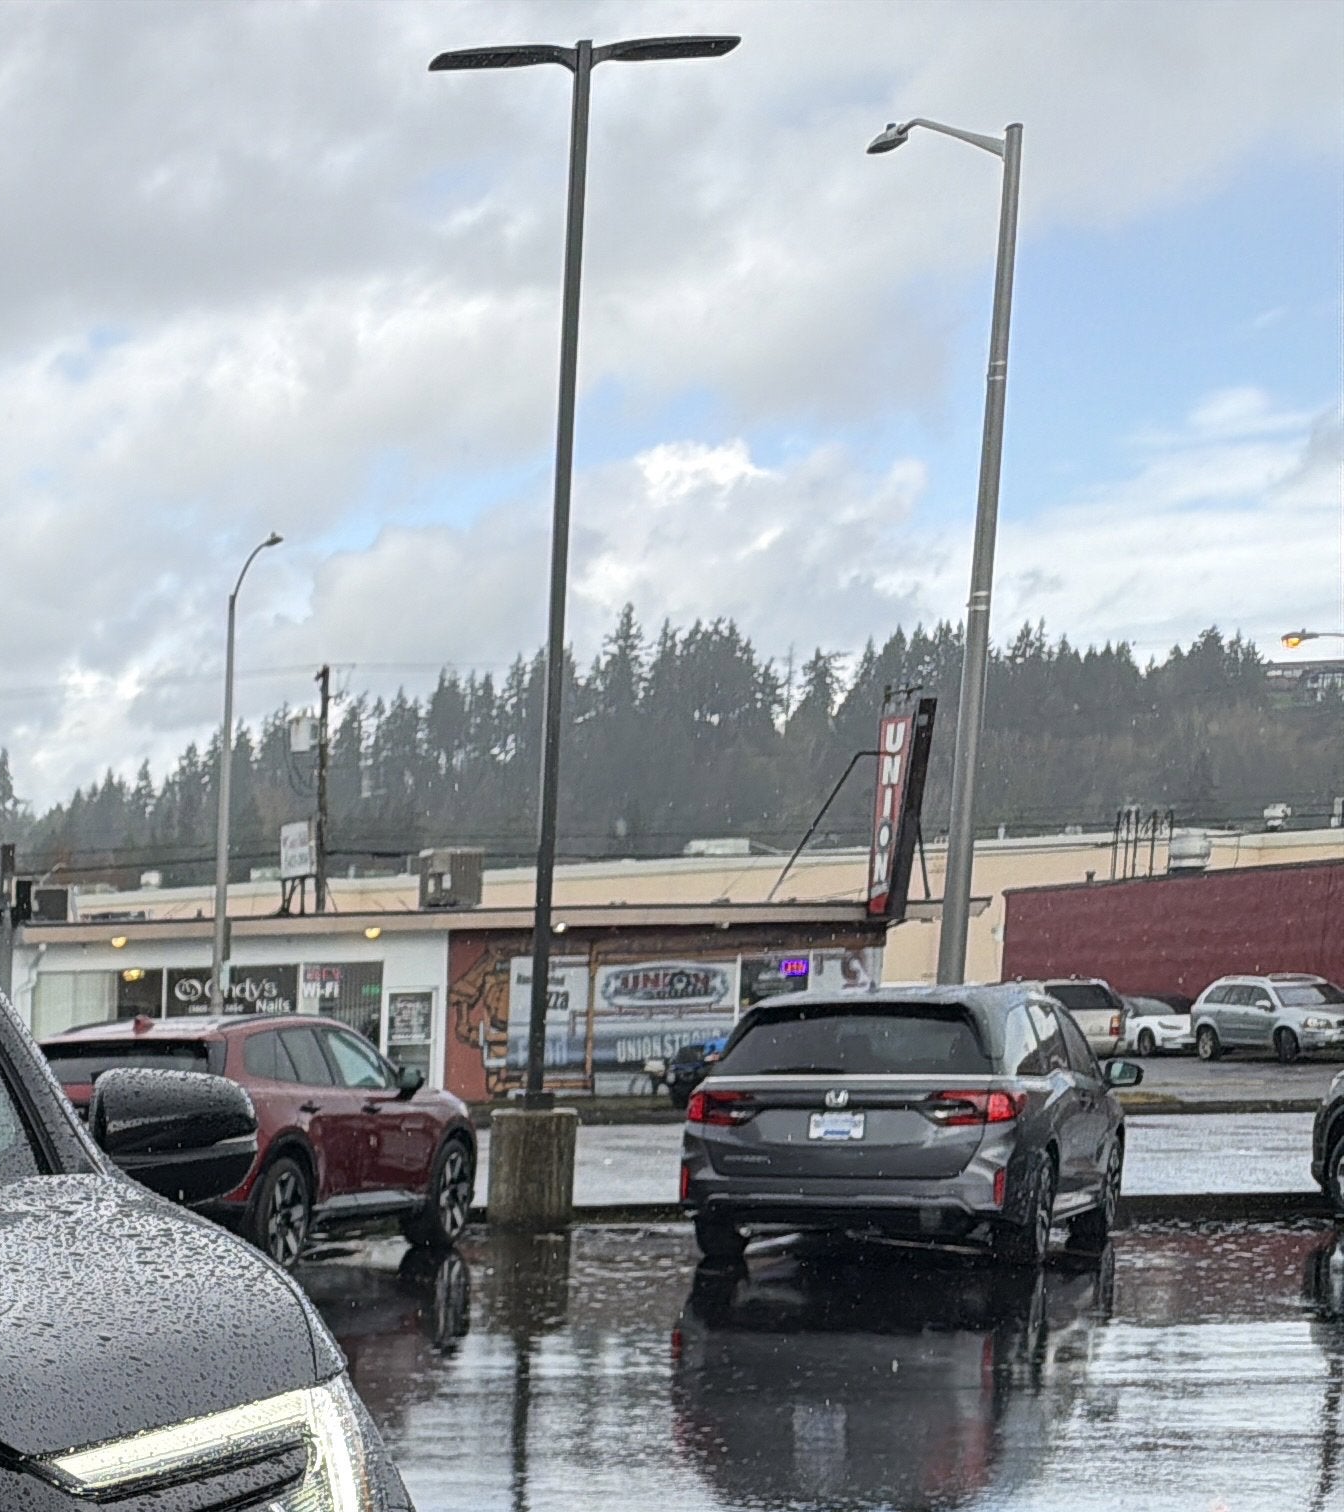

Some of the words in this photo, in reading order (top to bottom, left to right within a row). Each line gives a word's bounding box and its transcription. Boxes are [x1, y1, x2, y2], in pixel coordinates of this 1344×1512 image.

[874, 721, 905, 884] UNION
[204, 977, 278, 1002] Cndy's
[255, 996, 291, 1013] Nails
[616, 1034, 662, 1063] UNION
[663, 1027, 722, 1058] STRO
